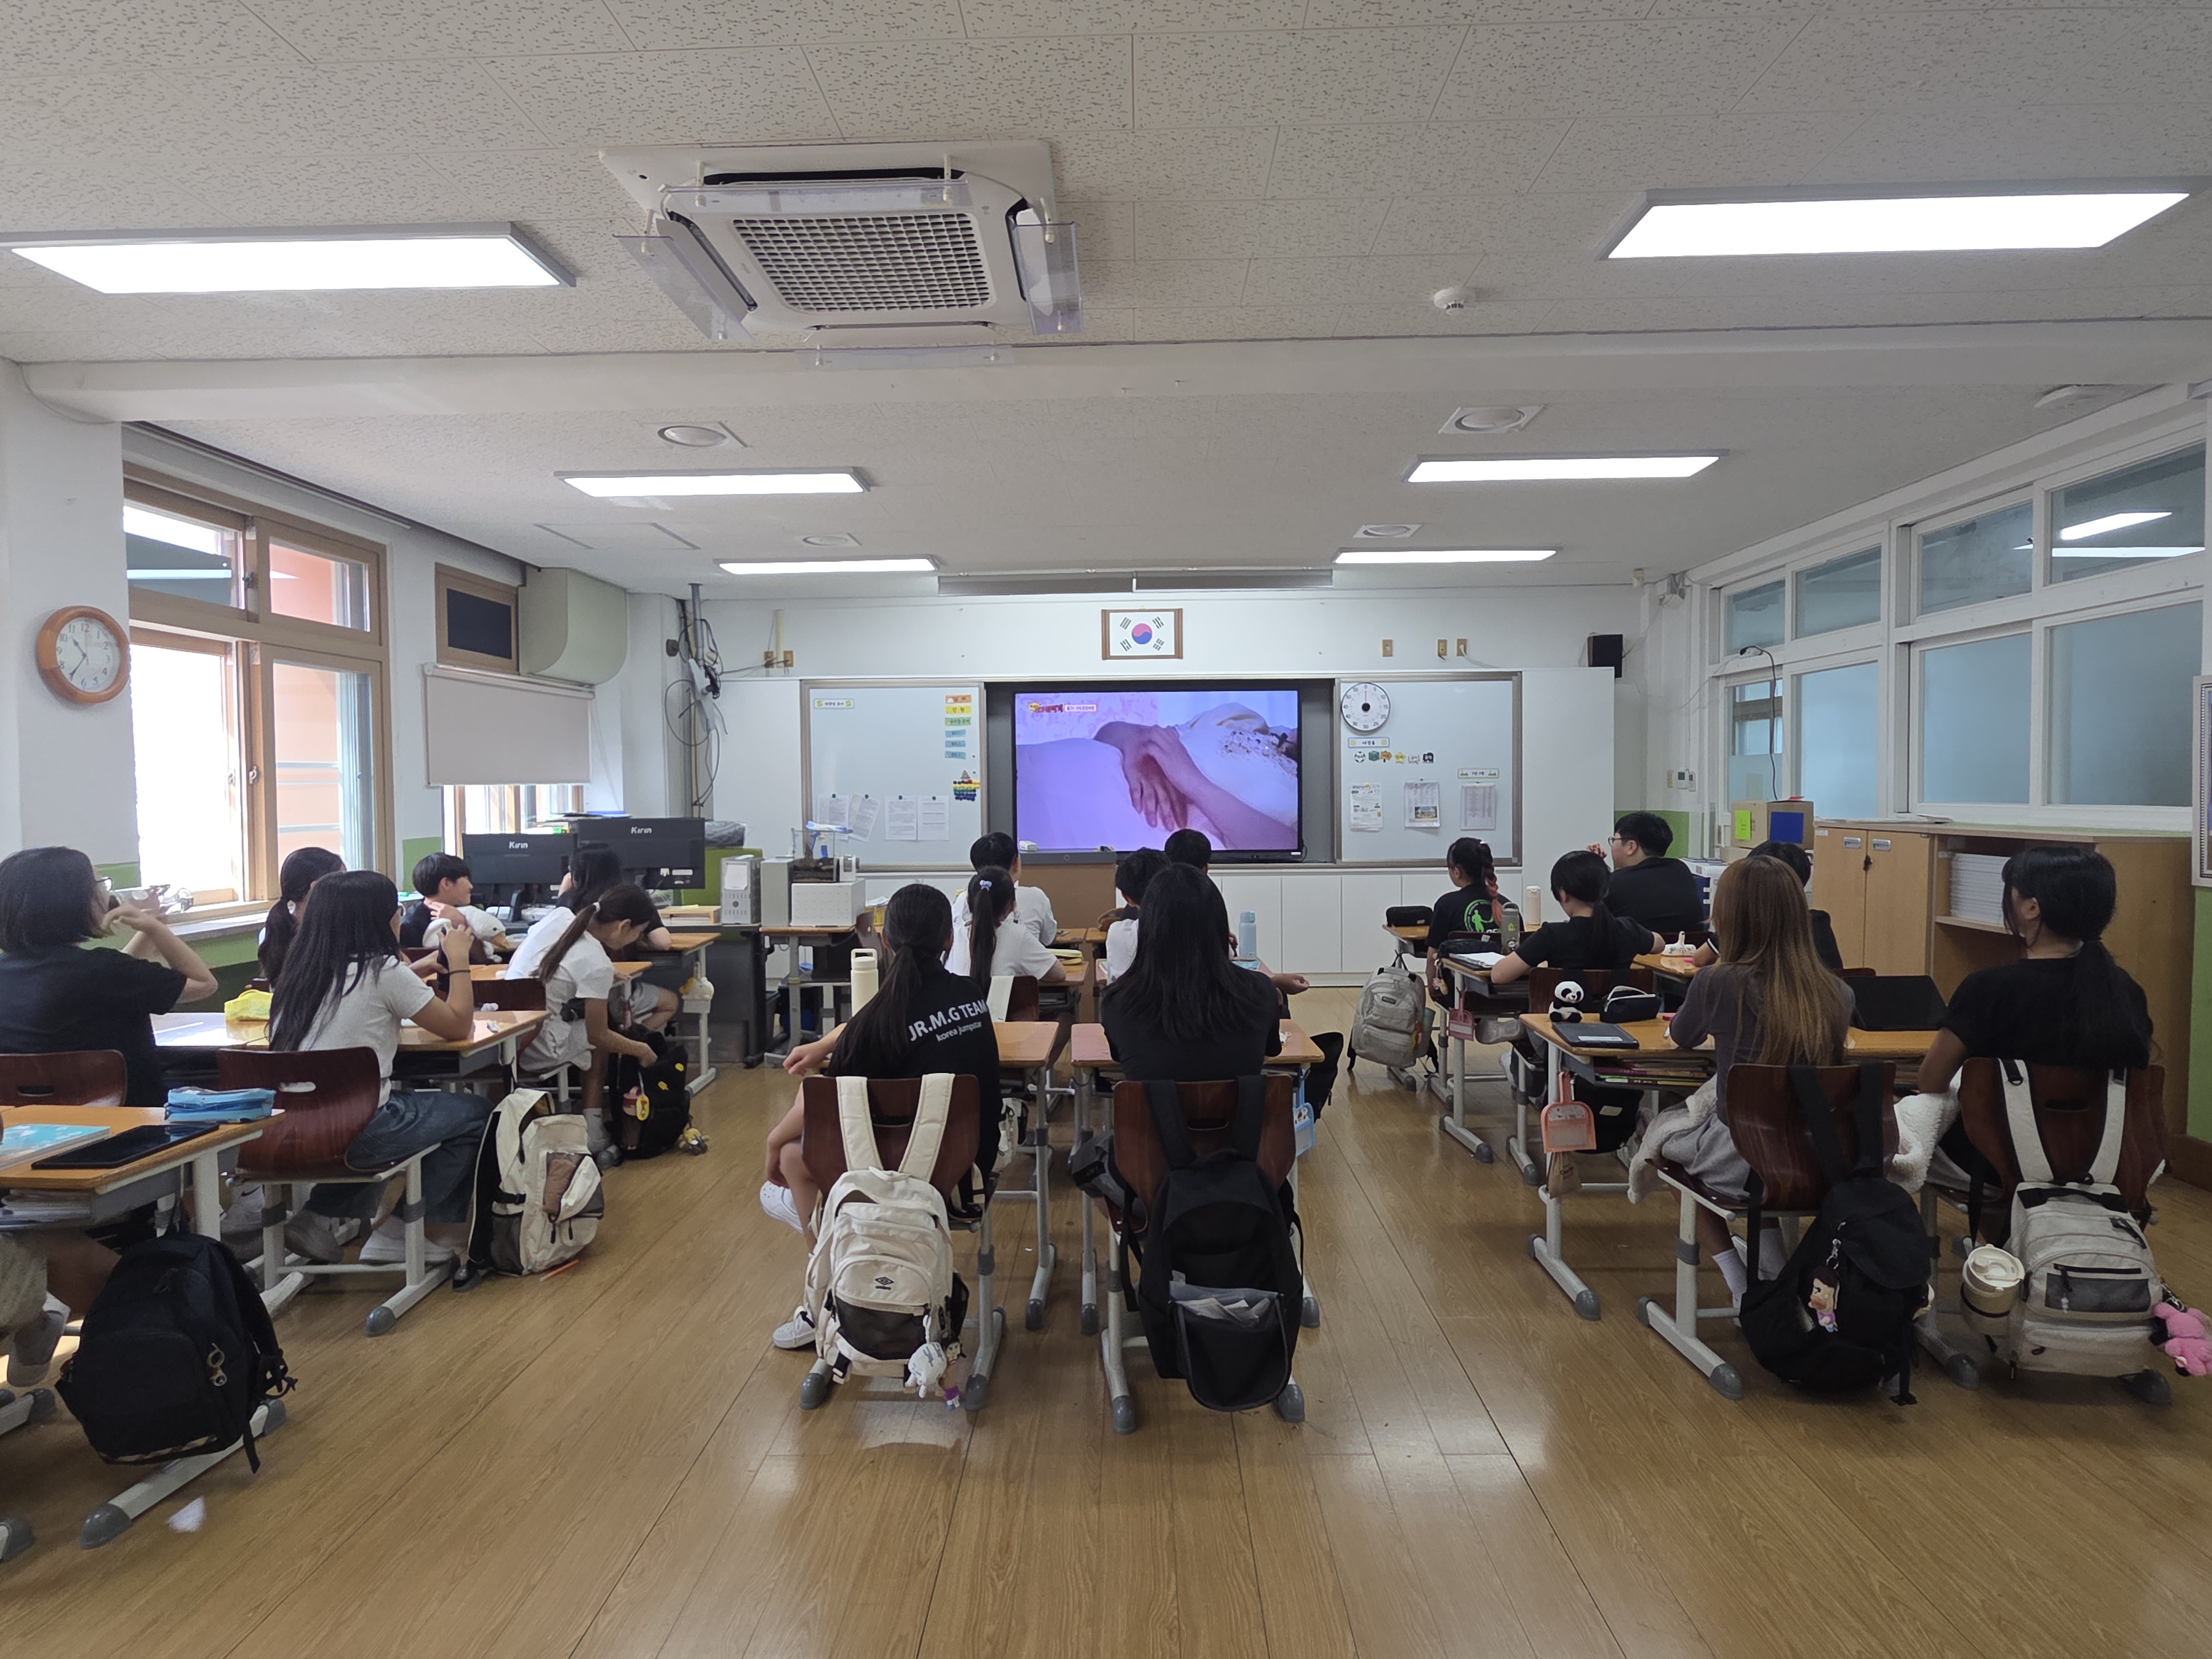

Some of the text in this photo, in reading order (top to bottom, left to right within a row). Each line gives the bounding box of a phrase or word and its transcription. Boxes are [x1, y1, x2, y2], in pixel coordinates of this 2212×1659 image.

[69, 624, 75, 633] 11
[81, 623, 90, 633] 12
[60, 633, 68, 643] 10
[97, 630, 100, 639] 1
[103, 641, 108, 650] 2
[56, 646, 62, 655] 9
[106, 655, 111, 663] 3
[60, 660, 65, 669] 8
[102, 667, 107, 676] 4
[81, 678, 86, 687] 6
[93, 676, 98, 685] 5
[509, 841, 529, 849] Kirin
[908, 999, 988, 1042] JR.M.G TEAM
[936, 1029, 958, 1042] korea
